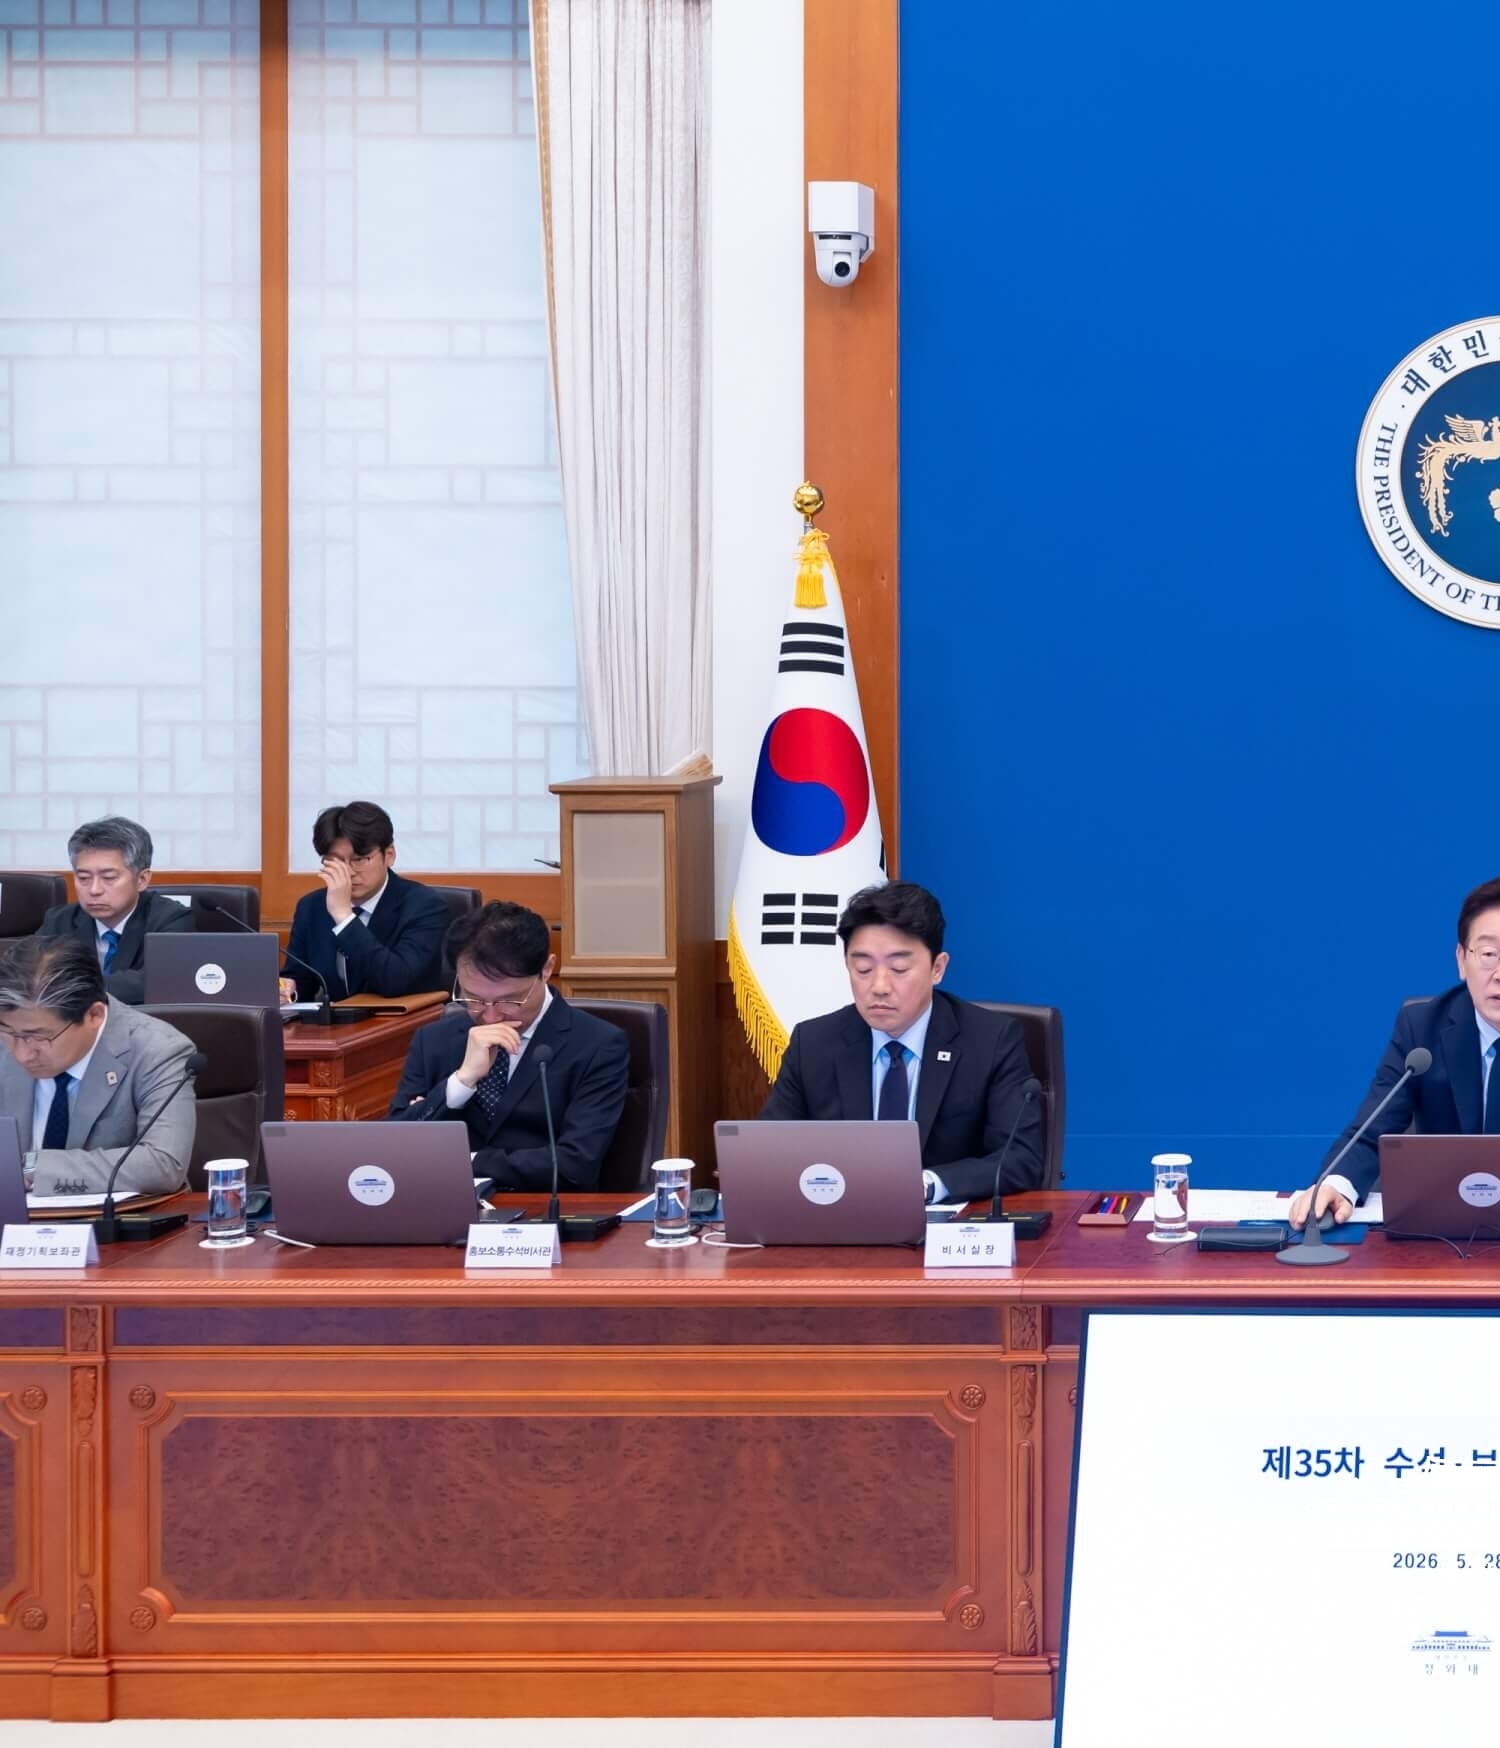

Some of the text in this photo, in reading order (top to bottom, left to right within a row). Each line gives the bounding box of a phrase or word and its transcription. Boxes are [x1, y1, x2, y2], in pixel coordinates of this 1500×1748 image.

[1373, 421, 1398, 469] THE
[1373, 474, 1445, 589] PRESIDENT
[1445, 581, 1477, 605] OF
[1261, 1446, 1365, 1480] 제35차
